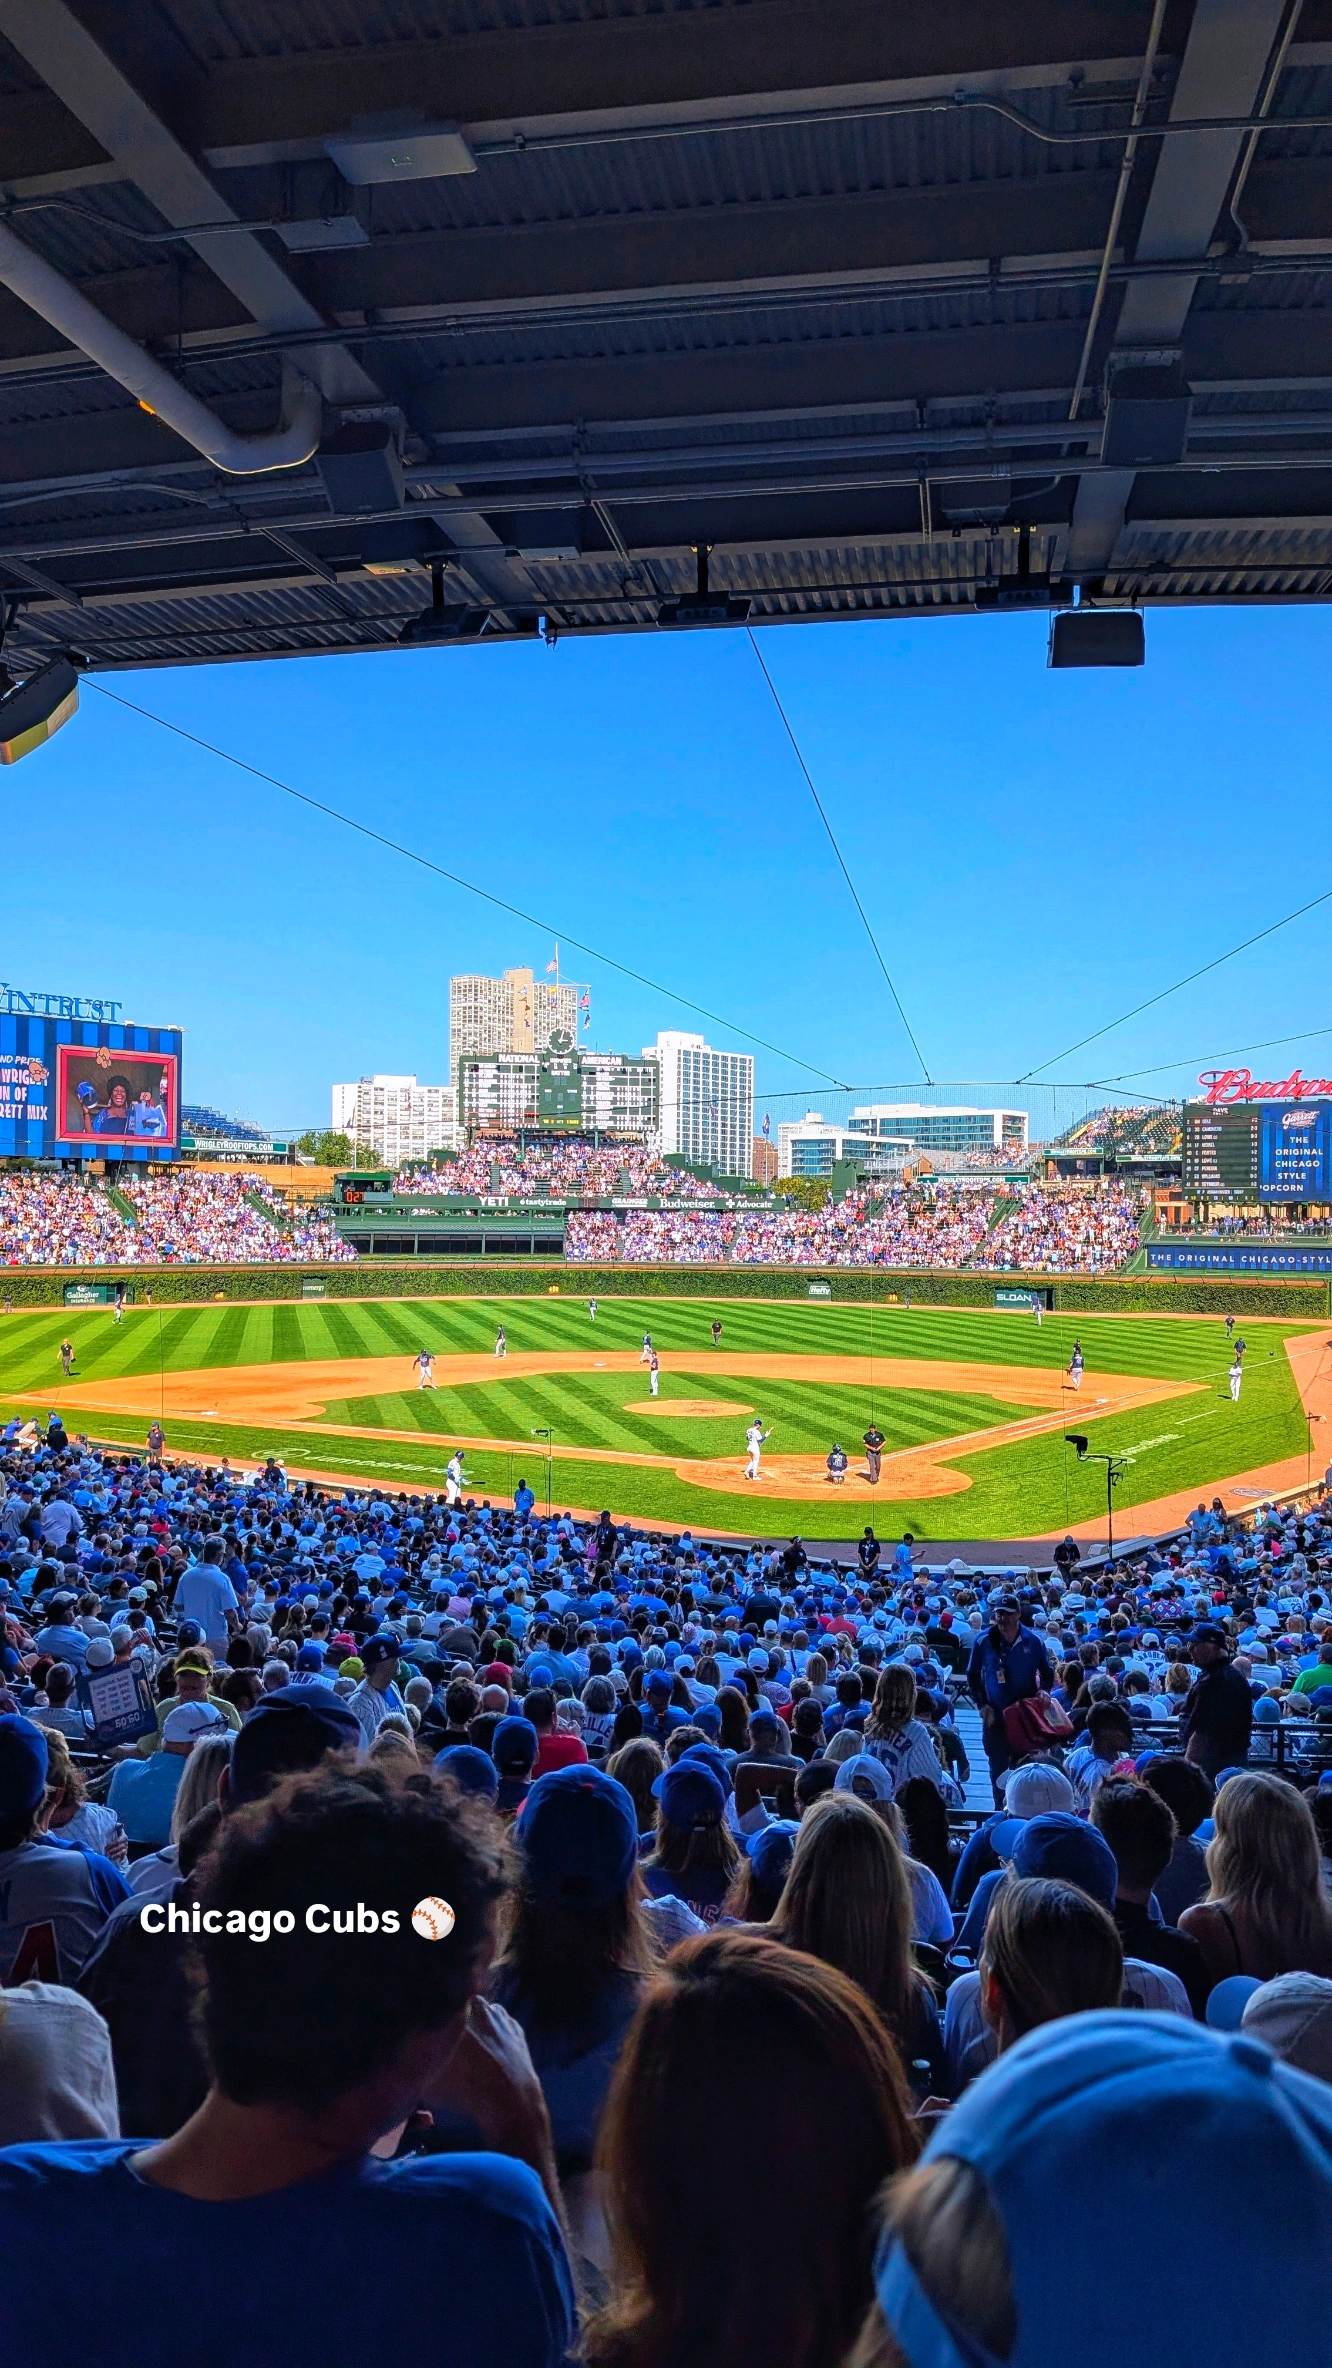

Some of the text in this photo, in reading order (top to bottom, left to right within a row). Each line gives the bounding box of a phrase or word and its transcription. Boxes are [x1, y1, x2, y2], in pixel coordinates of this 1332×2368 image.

[499, 1053, 540, 1063] NATIONAL
[582, 1056, 622, 1065] AMERICAN
[14, 1086, 28, 1101] OF
[27, 1105, 48, 1120] MIX
[1282, 1110, 1320, 1130] Garrett
[1290, 1136, 1309, 1144] THE
[195, 1140, 274, 1151] WRIGLEYROOFTOPS.COM
[1275, 1148, 1324, 1156] ORIGINAL
[1275, 1160, 1321, 1168] CHICAGO
[1278, 1172, 1307, 1180] STYLE
[479, 1196, 509, 1207] YETI
[525, 1198, 567, 1207] tastytrade
[736, 1200, 773, 1209] Advocate
[1151, 1253, 1172, 1261] THE
[1178, 1254, 1235, 1263] ORIGINAL
[66, 1291, 100, 1301] Gallagher
[996, 1293, 1032, 1302] SLOAN
[410, 1552, 420, 1562] 12
